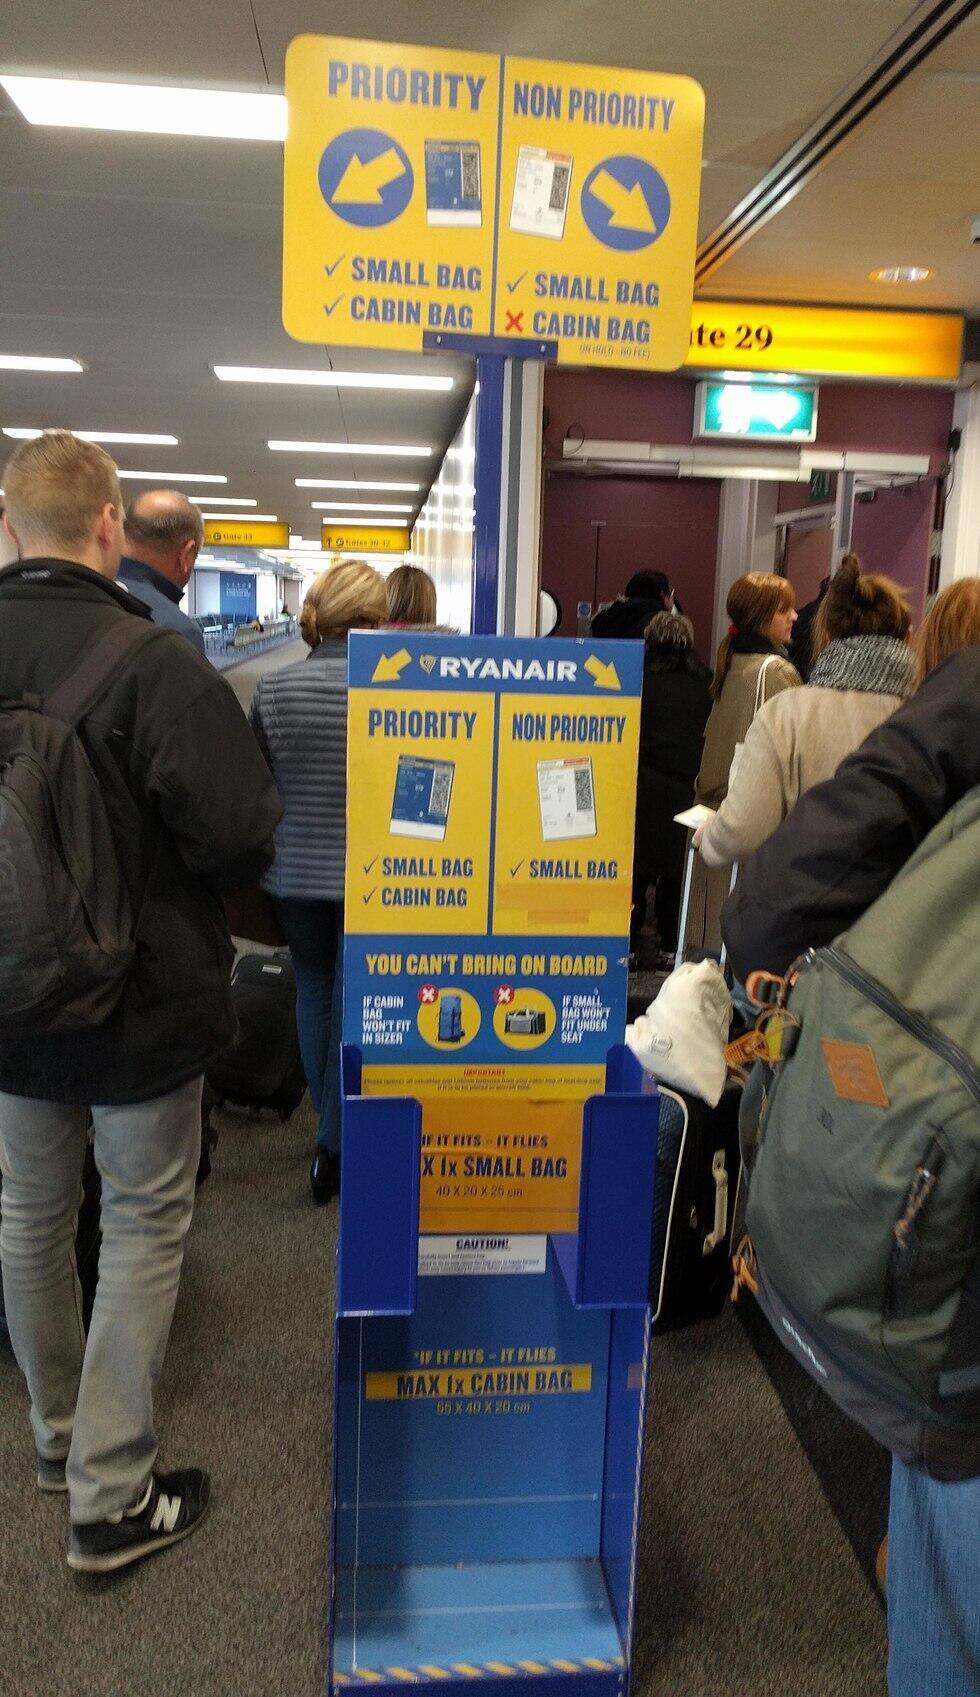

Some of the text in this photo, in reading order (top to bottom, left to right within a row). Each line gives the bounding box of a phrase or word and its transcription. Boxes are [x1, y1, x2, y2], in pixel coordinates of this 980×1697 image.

[328, 60, 486, 112] PRIORITY
[514, 81, 675, 131] NON PRIORITY
[351, 256, 482, 291] SMALL BAG
[534, 273, 660, 307] SMALL BAG
[350, 296, 473, 329] CABIN BAG
[532, 312, 651, 344] CABIN BAG
[689, 322, 773, 351] te 29
[440, 656, 578, 682] RYANAIR
[368, 709, 477, 740] PRIORITY
[512, 713, 626, 743] NON PRIORITY
[382, 858, 474, 878] SMALL BAG
[529, 859, 618, 879] SMALL BAG
[381, 887, 467, 907] CABIN BAG
[366, 953, 608, 977] YOU CAN'T BRING ON BOARD
[363, 995, 404, 1009] IF CABIN
[562, 994, 602, 1008] IF SMALL
[363, 1008, 383, 1021] BAG
[562, 1006, 611, 1020] BAG WON'T
[362, 1020, 412, 1032] WON'T FIT
[561, 1019, 608, 1032] FIT UNDER
[362, 1032, 403, 1045] IN SIZER
[561, 1030, 583, 1044] SEAT
[437, 1134, 449, 1147] IT
[453, 1134, 481, 1147] FITS
[497, 1134, 509, 1147] IT
[512, 1134, 548, 1148] FLIES
[463, 1155, 526, 1178] SMALL
[531, 1156, 567, 1178] BAG
[436, 1185, 450, 1197] 40
[463, 1185, 478, 1197] 20
[507, 1187, 523, 1197] cm
[456, 1239, 510, 1251] CAUTION!
[436, 1349, 449, 1365] IT
[453, 1348, 484, 1364] FITS
[501, 1347, 514, 1363] IT
[518, 1346, 557, 1363] FLIES
[397, 1374, 440, 1396] MAX
[471, 1371, 529, 1393] CABIN
[535, 1368, 573, 1391] BAG
[466, 1401, 481, 1415] 40
[513, 1402, 530, 1414] cm
